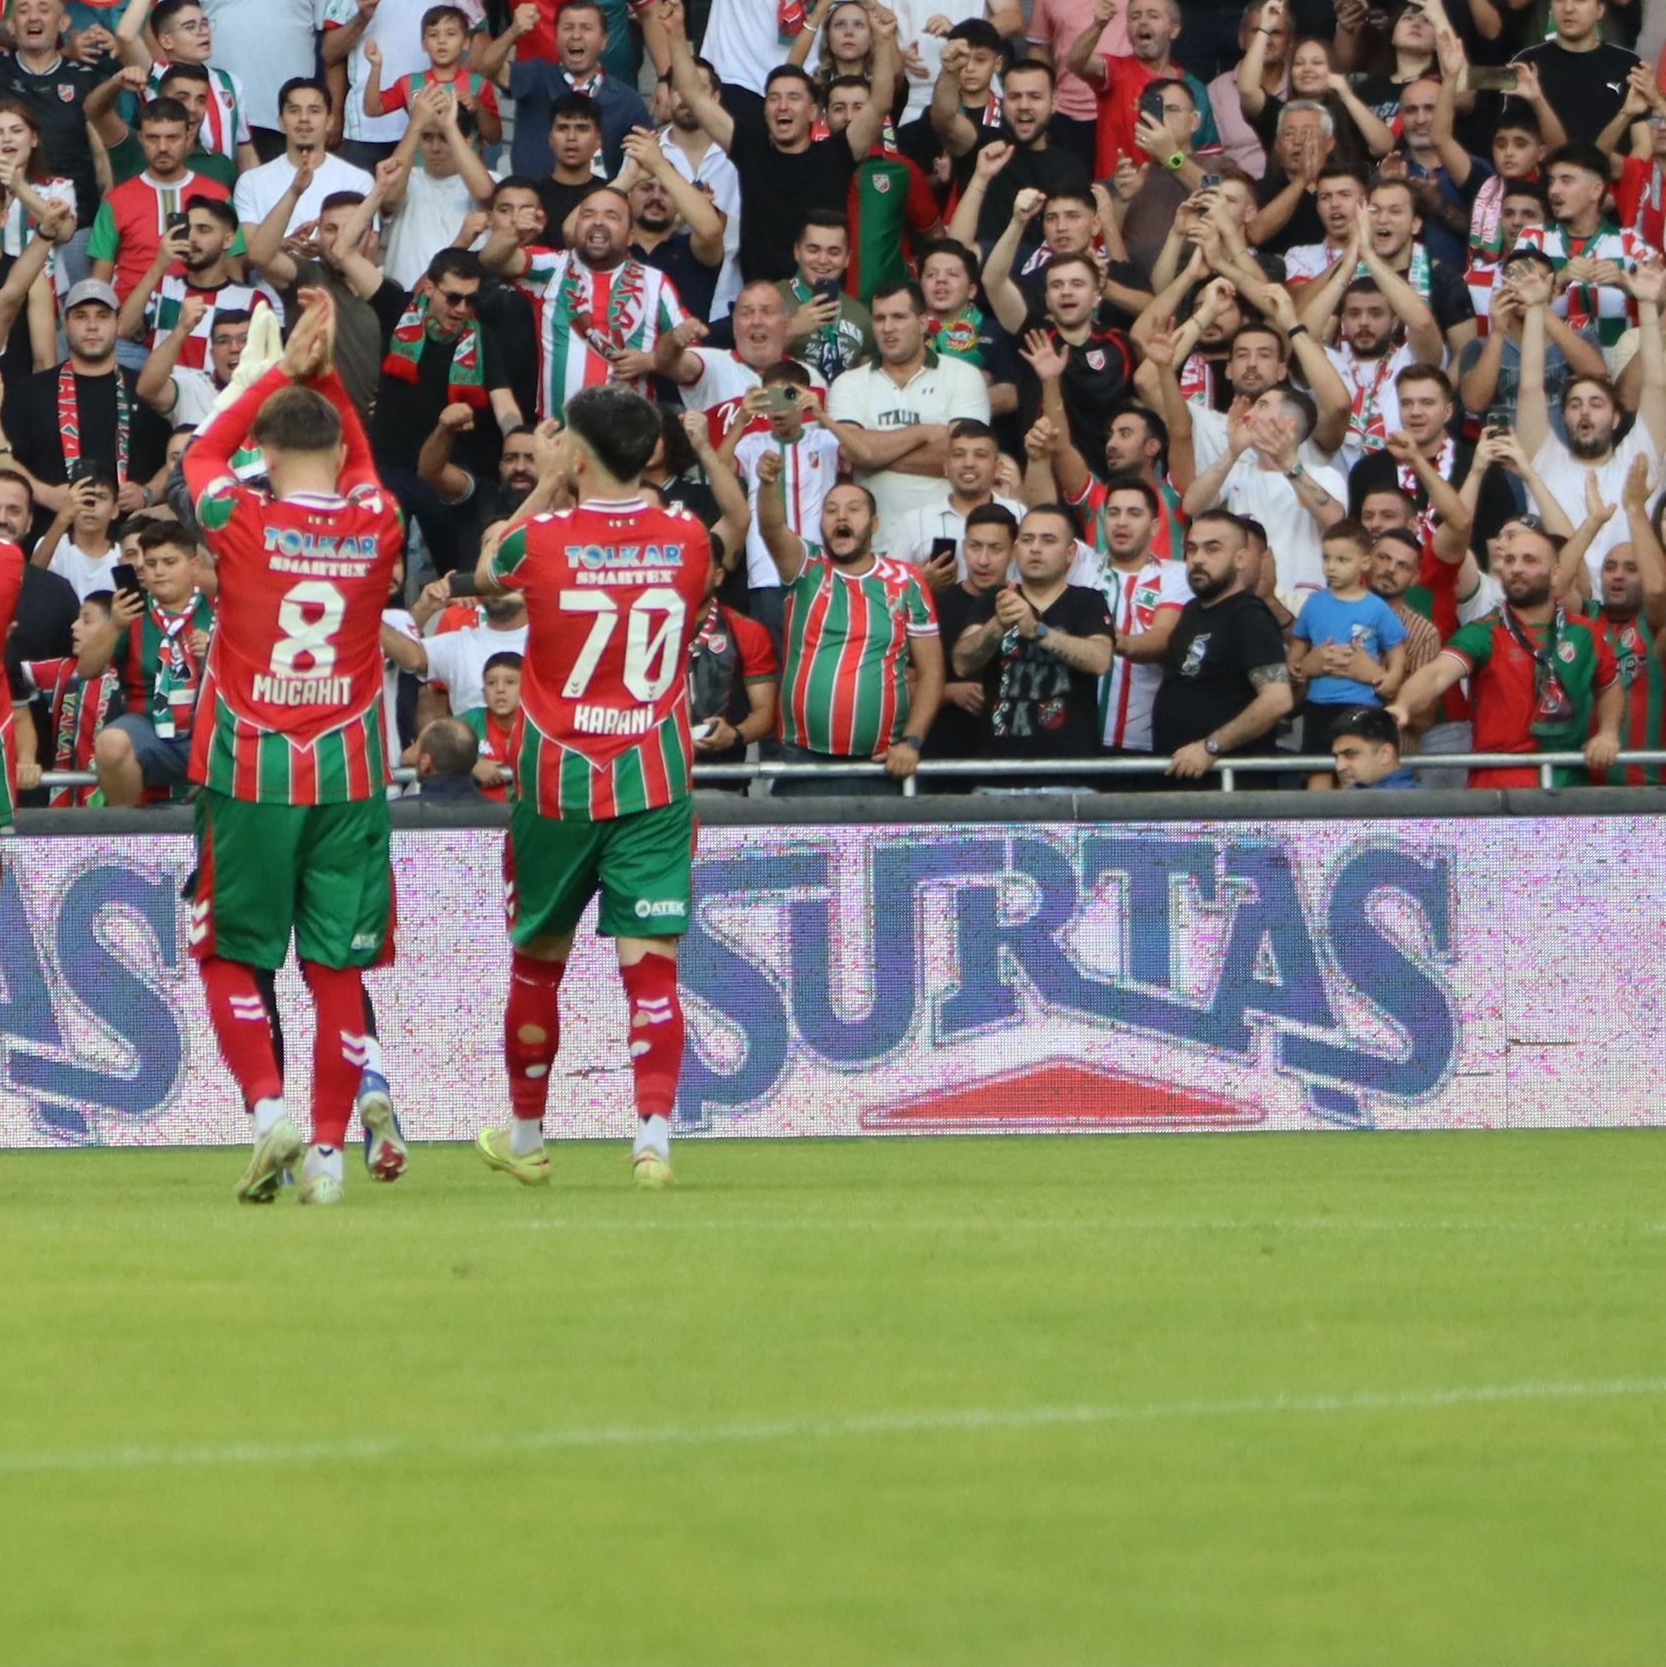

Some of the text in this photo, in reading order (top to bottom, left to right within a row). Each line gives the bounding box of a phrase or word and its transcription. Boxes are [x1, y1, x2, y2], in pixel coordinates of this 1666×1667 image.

[877, 410, 922, 426] ITALIA
[264, 527, 377, 559] TOLKAR
[268, 556, 369, 578] SMARTEX
[564, 544, 683, 569] TOLKAR
[575, 570, 673, 585] SMARTEX
[269, 580, 345, 679] 8
[559, 588, 685, 703] 70
[651, 900, 685, 916] ATEK
